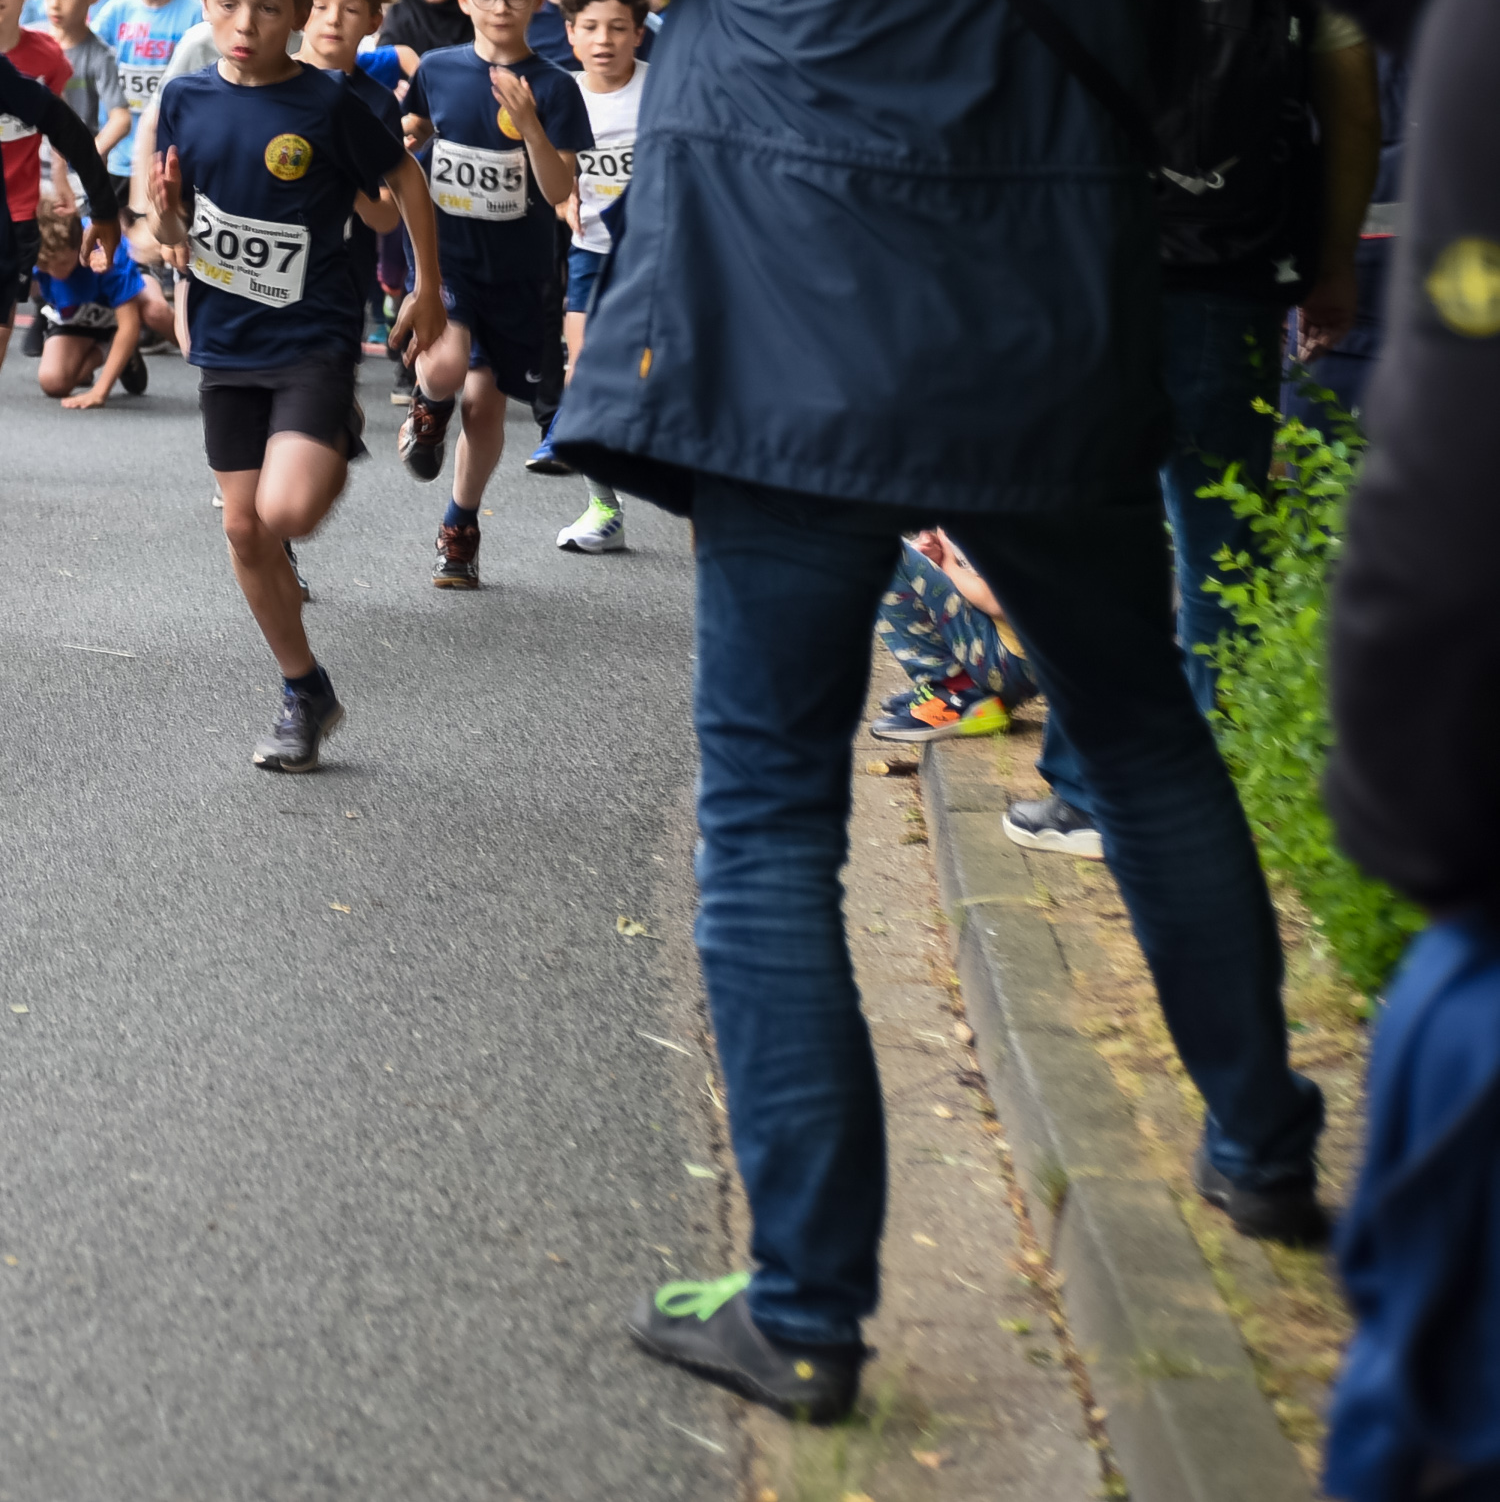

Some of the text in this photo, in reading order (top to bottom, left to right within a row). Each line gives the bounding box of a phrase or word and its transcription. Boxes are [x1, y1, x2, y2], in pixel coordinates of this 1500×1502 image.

[435, 157, 523, 193] 2085
[191, 214, 304, 274] 2097
[195, 257, 235, 286] EWE
[248, 277, 291, 300] bruns
